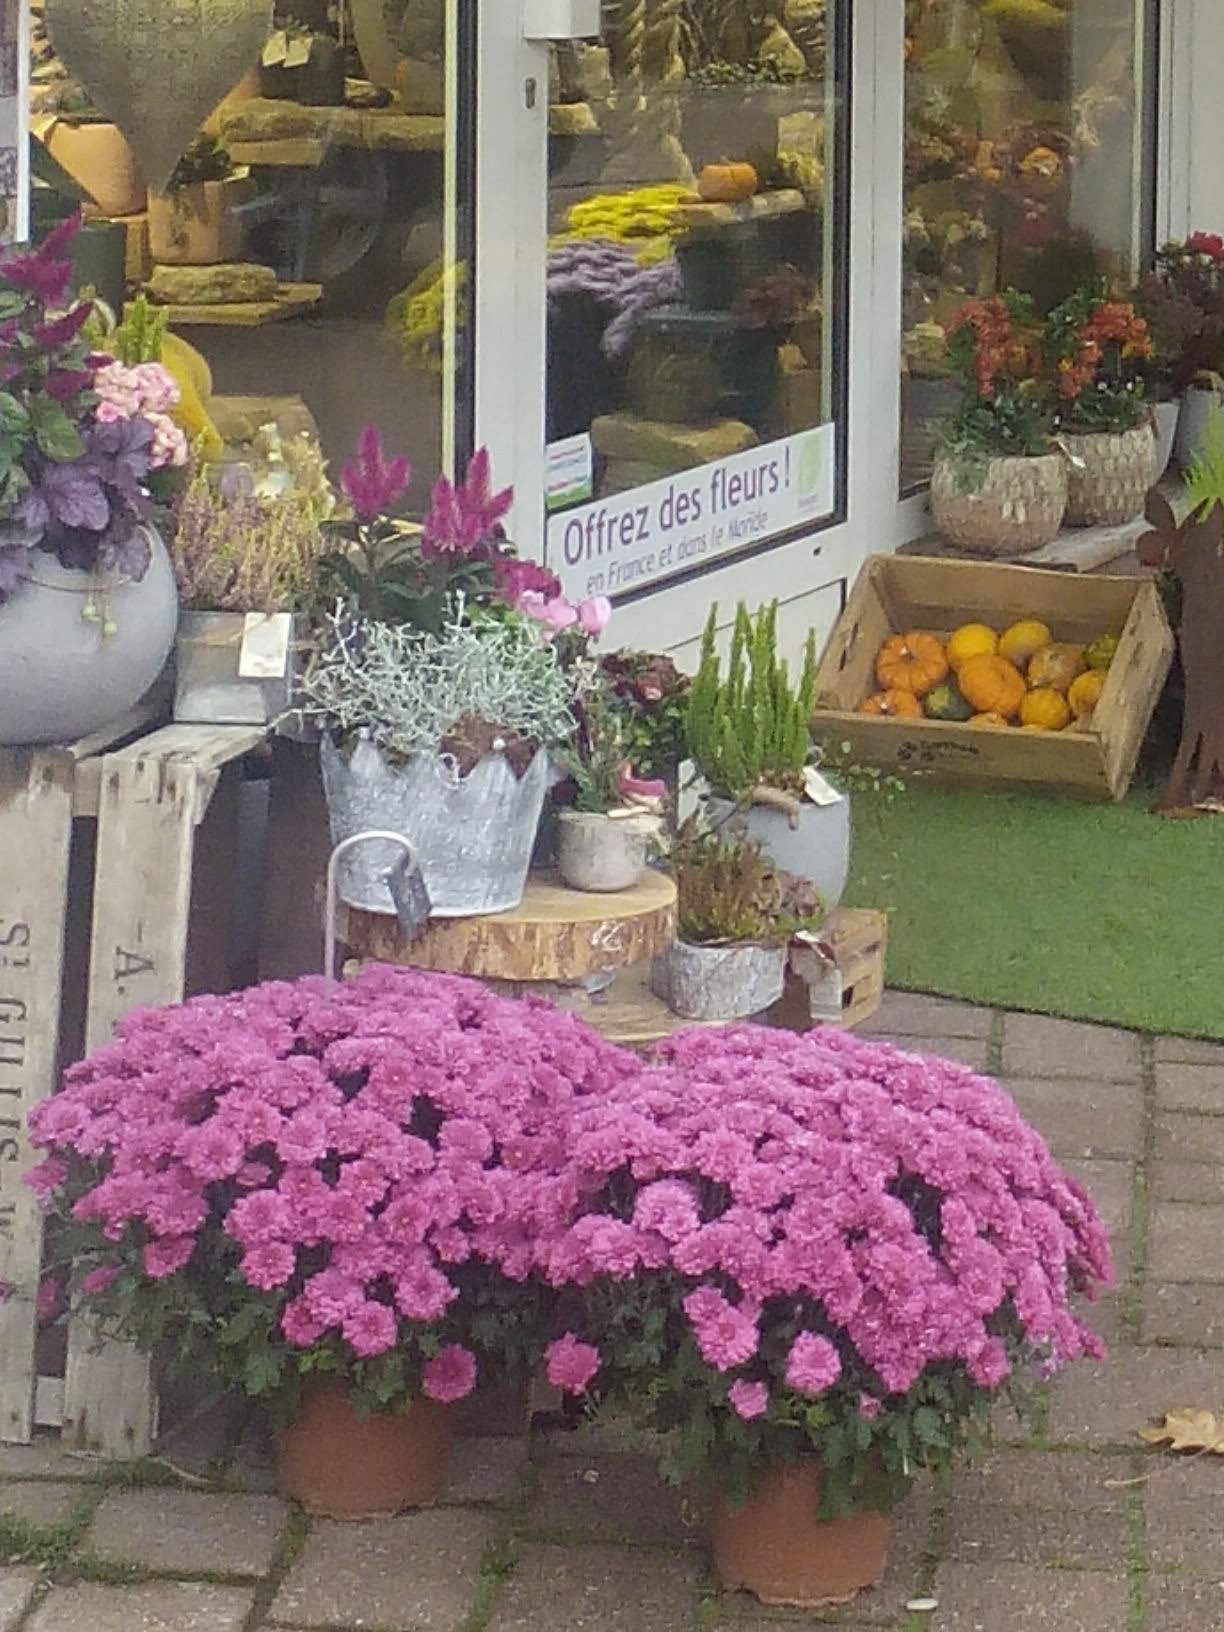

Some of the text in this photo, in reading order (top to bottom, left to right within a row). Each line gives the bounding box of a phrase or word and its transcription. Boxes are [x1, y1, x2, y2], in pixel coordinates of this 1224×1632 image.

[564, 505, 650, 566] Offrez
[659, 484, 701, 531] des
[711, 460, 779, 514] fleurs
[587, 573, 605, 594] en
[608, 555, 657, 587] France
[659, 543, 673, 567] et
[678, 531, 707, 561] dans
